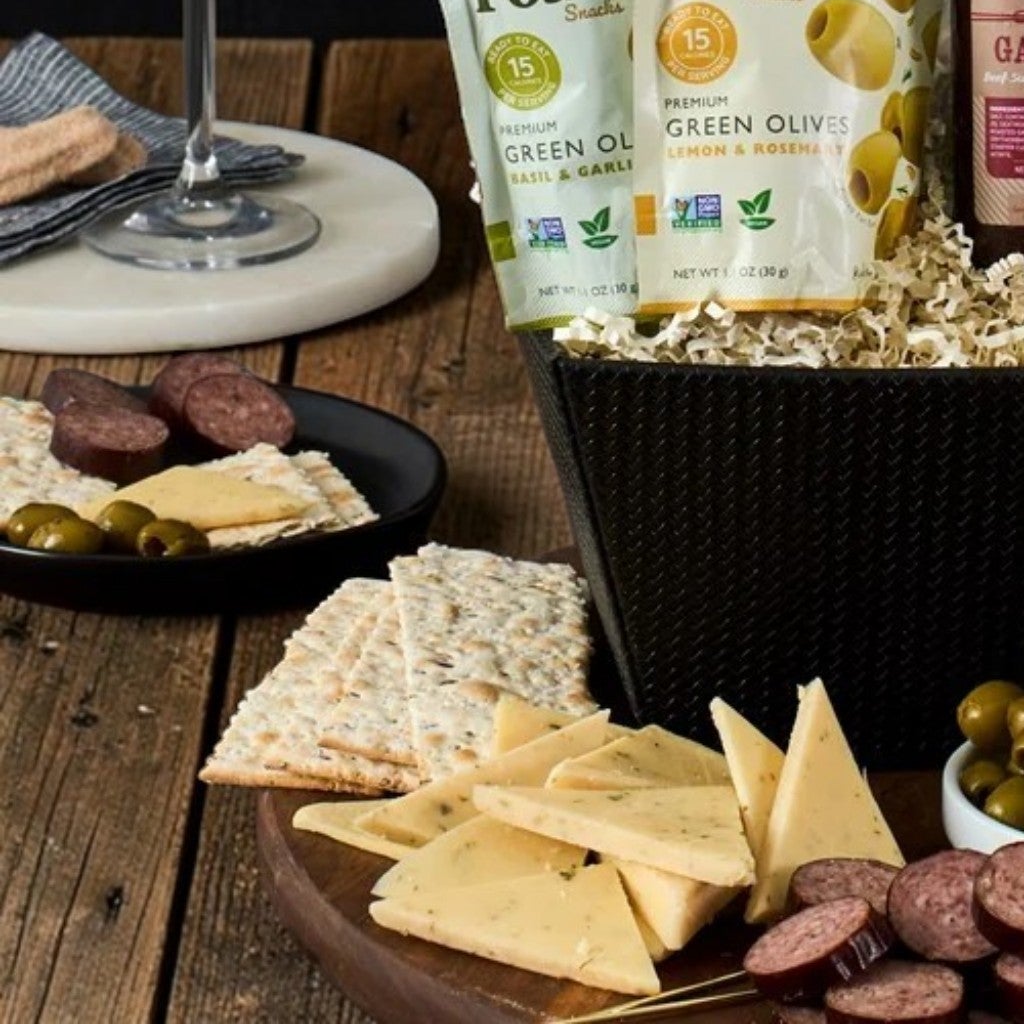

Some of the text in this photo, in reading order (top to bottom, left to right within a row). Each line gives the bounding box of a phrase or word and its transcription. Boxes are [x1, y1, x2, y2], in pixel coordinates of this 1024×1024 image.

[712, 12, 730, 30] EAT
[683, 28, 710, 51] 15
[507, 56, 535, 78] 15
[664, 96, 728, 110] PREMIUM
[499, 121, 558, 136] PREMIUM
[665, 114, 849, 138] GREEN OLIVES
[505, 132, 634, 163] GREEN OL
[667, 144, 727, 159] LEMON
[734, 143, 746, 156] &
[511, 159, 633, 185] BASIL & GARLI
[673, 268, 696, 279] NET
[700, 267, 719, 277] WT
[739, 267, 756, 277] OZ
[538, 285, 560, 297] NET
[590, 286, 608, 296] OZ
